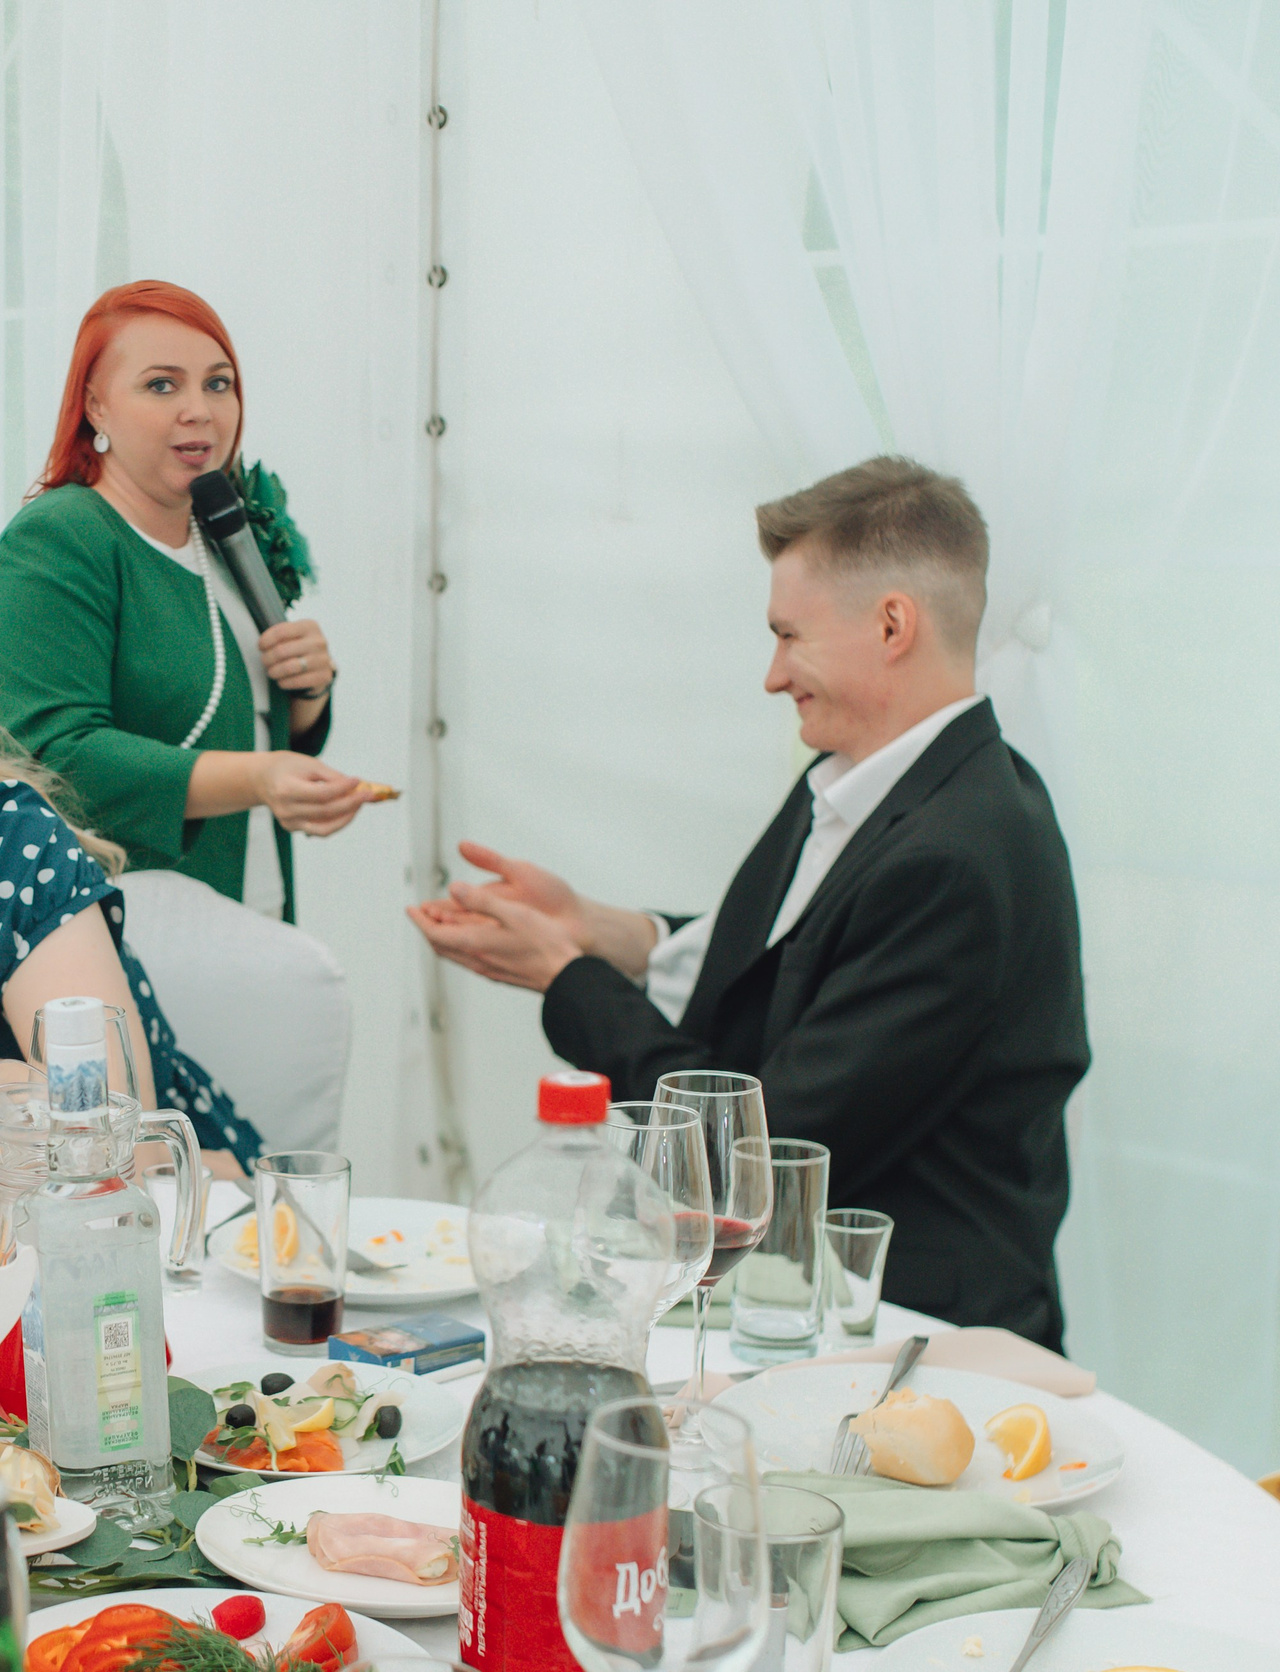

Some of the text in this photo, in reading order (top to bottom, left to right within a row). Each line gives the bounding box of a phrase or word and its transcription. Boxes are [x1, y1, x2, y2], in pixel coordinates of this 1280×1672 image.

[102, 1405, 139, 1416] СПЕЦИАЛЬНАЯ
[102, 1410, 139, 1420] ФЕДЕРАЛЬНАЯ
[104, 1431, 139, 1441] ФЕДЕРАЦИЯ
[104, 1435, 139, 1446] РОССИЙСКАЯ
[477, 1521, 488, 1658] ПЕРЕРАБАТЫВАЕМАЯ
